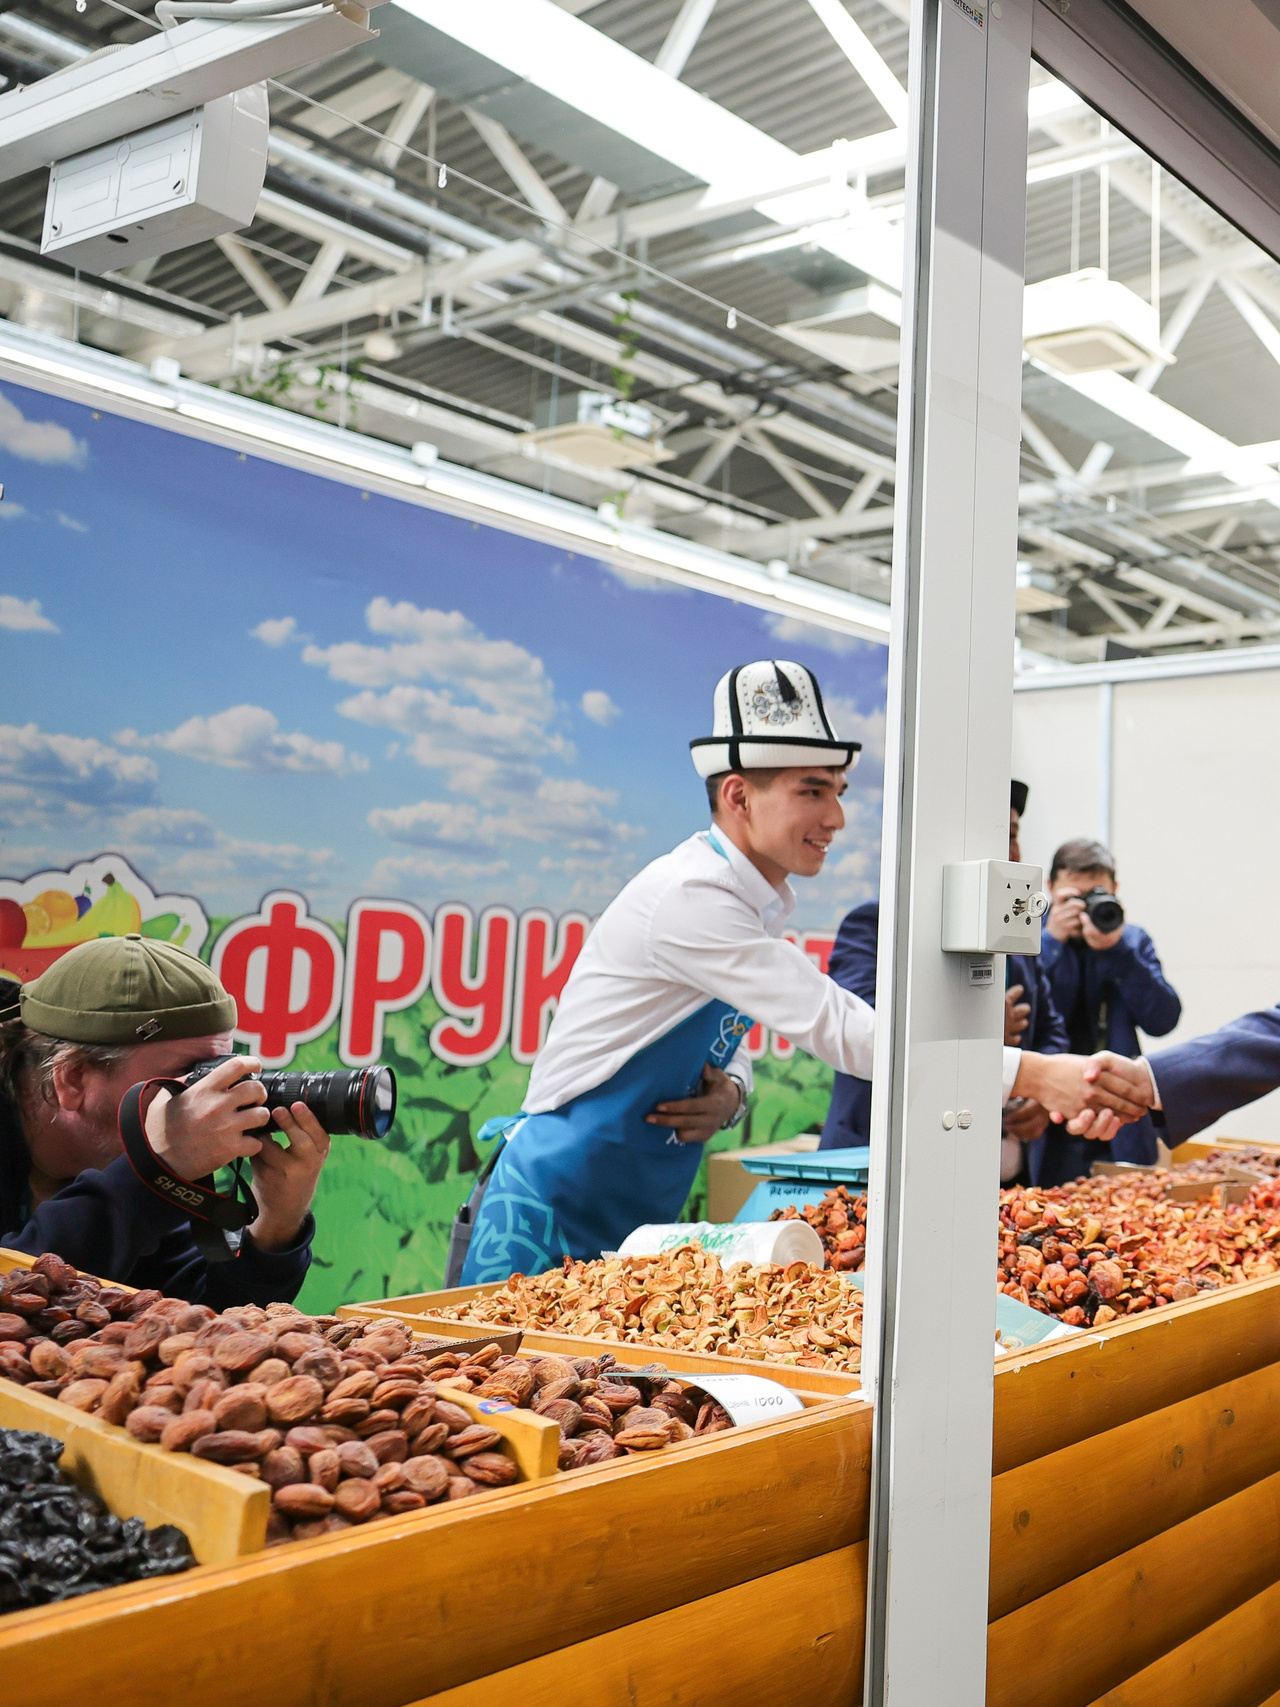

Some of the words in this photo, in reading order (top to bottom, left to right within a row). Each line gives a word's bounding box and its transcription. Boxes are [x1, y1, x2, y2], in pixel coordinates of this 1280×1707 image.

[953, 0, 974, 17] UTECH
[216, 899, 596, 1061] ФРУК
[155, 1176, 175, 1190] R5
[172, 1187, 204, 1205] EOS
[725, 1399, 750, 1410] Цена
[754, 1395, 784, 1408] 1000
